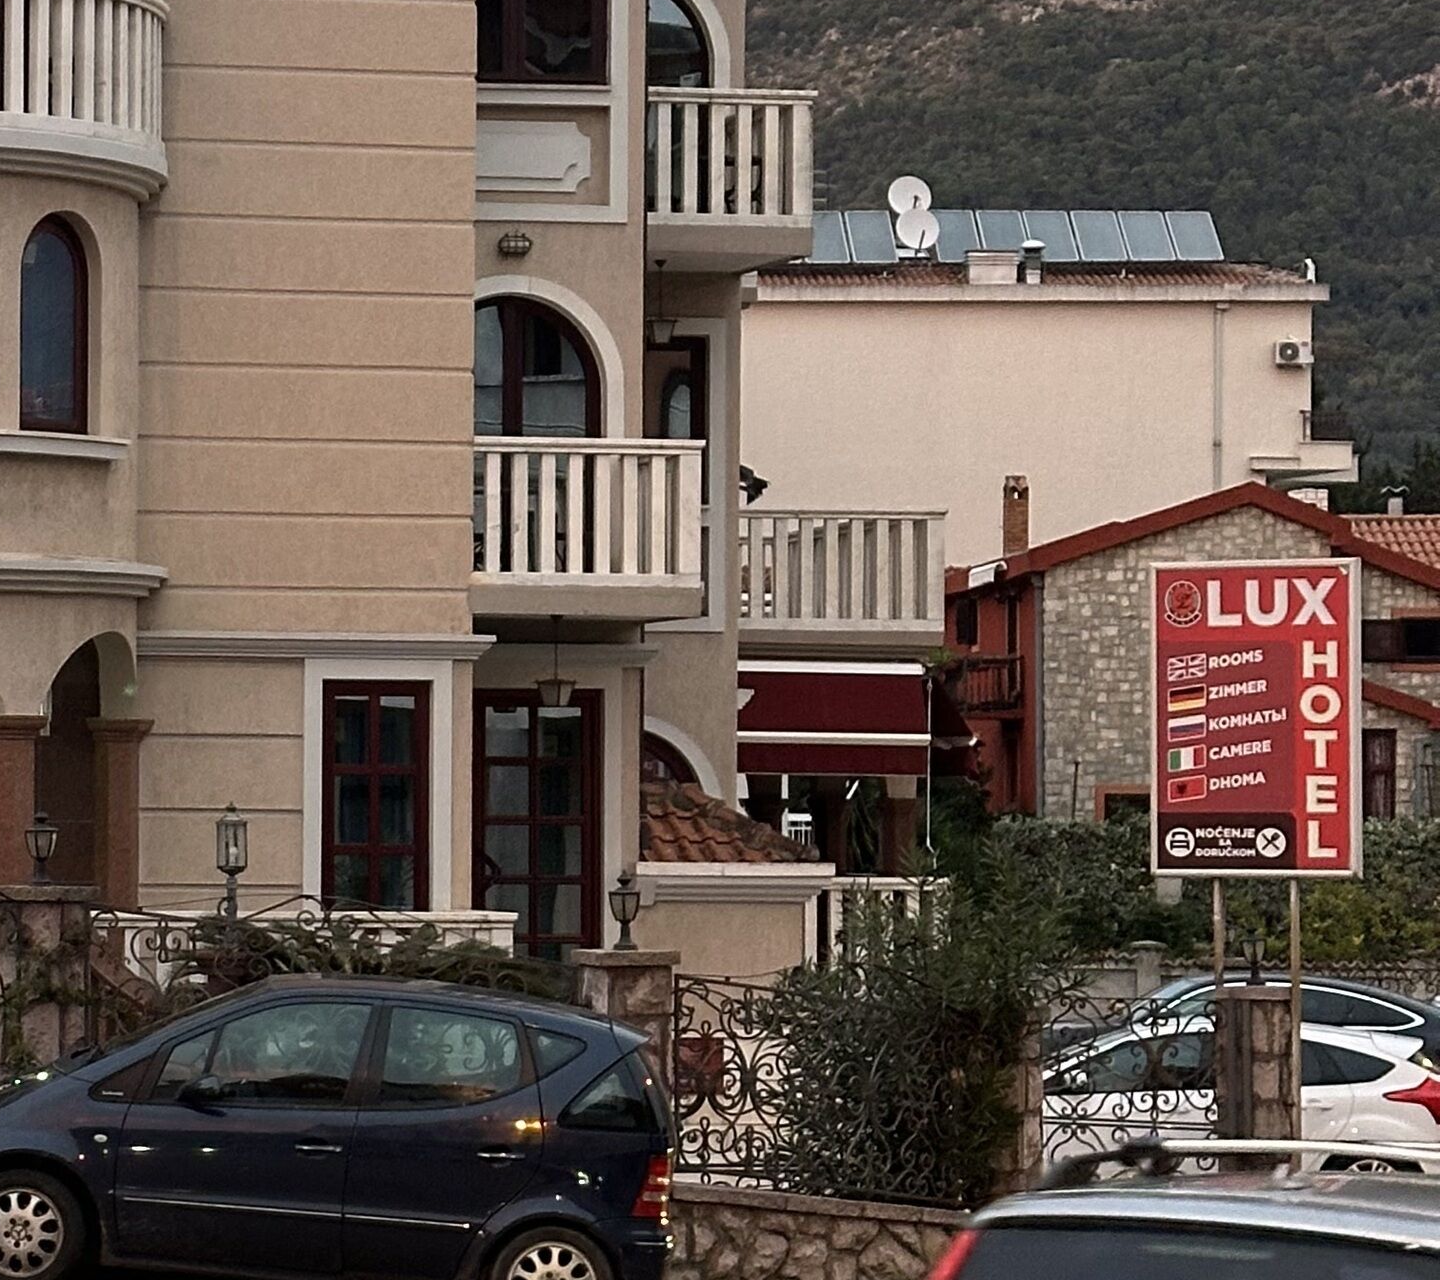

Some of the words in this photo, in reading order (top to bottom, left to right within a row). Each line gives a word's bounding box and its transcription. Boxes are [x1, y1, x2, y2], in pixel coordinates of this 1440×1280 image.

[1207, 578, 1337, 627] LUX
[1208, 650, 1263, 669] ROOMS
[1208, 680, 1267, 699] ZIMMER
[1208, 708, 1287, 731] КОМНАТЫ
[1209, 740, 1272, 760] CAMERE
[1300, 641, 1341, 858] HOTEL
[1209, 771, 1266, 791] DHOMA
